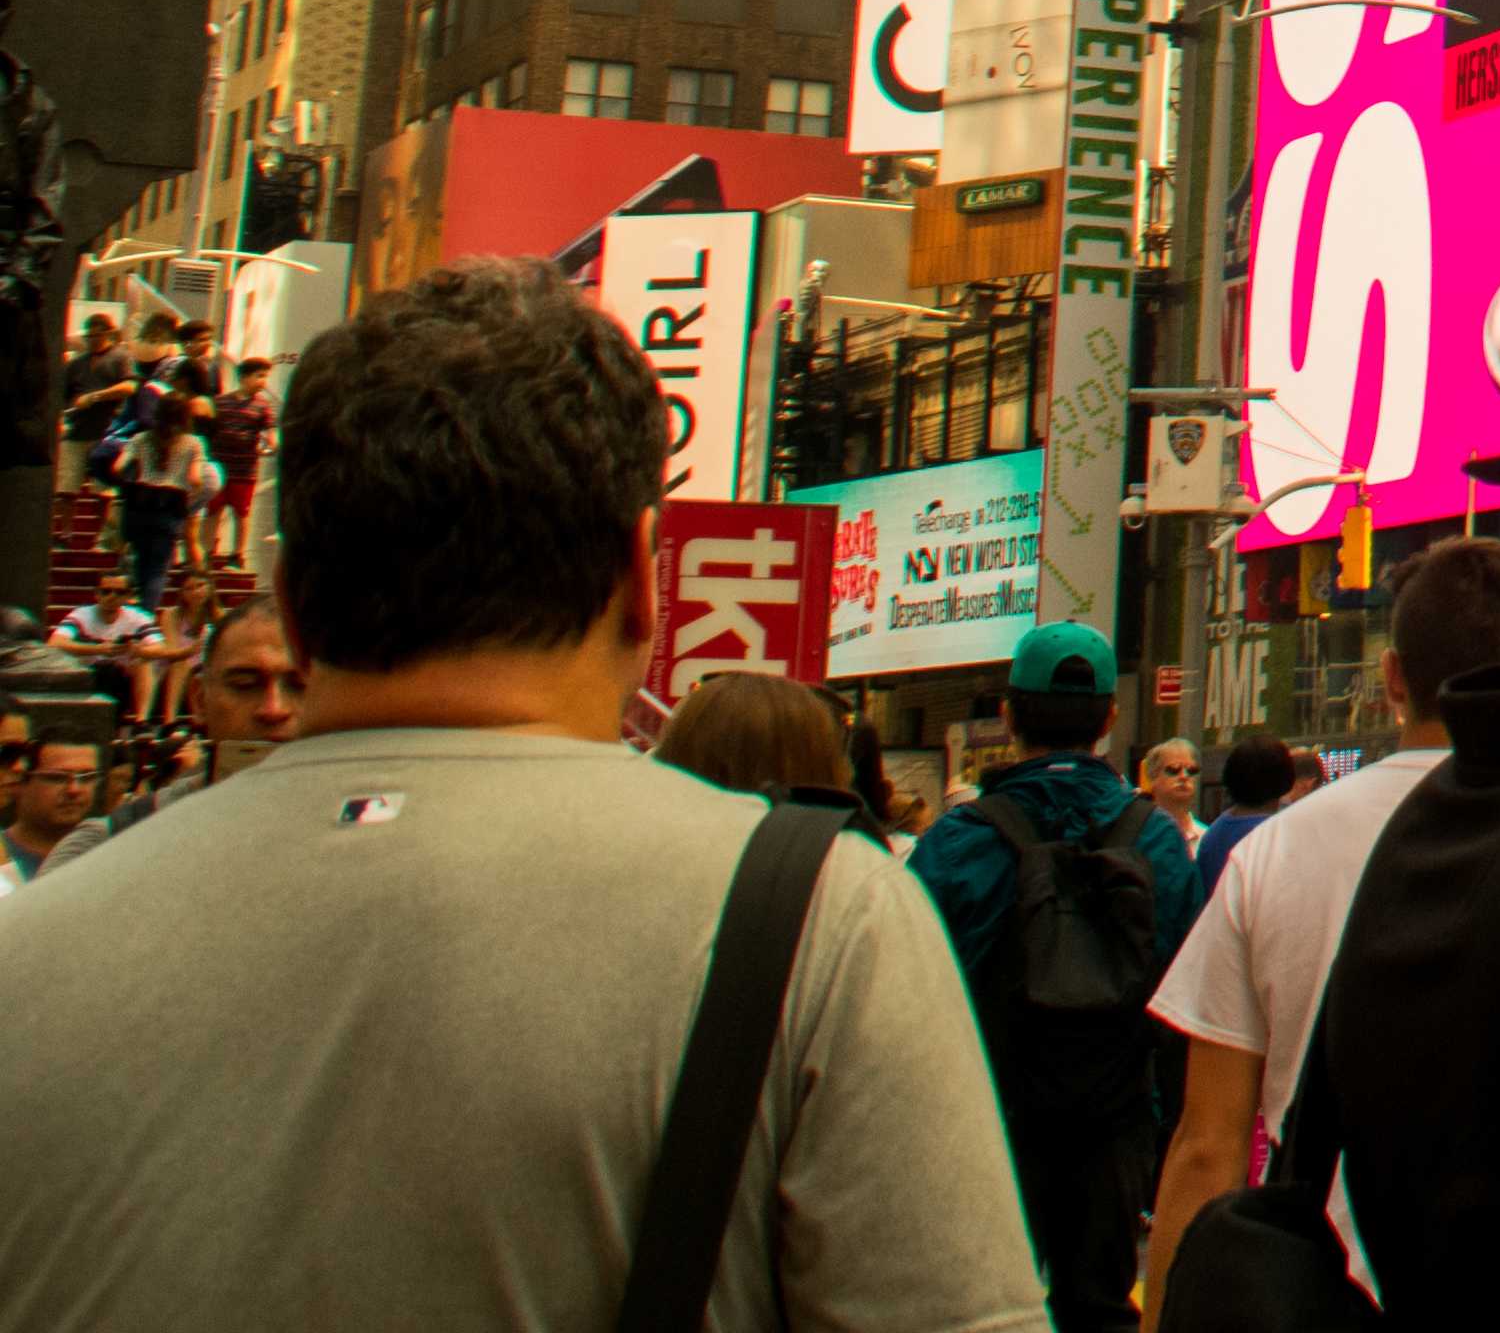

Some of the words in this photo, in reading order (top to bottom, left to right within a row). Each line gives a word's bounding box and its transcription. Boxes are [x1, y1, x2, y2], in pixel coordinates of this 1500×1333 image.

[965, 184, 1030, 207] LAMAR
[945, 543, 973, 577] NEW
[974, 535, 1017, 572] WORLD
[1018, 532, 1040, 567] STA
[669, 527, 801, 699] tkt
[651, 659, 667, 695] Devel
[1203, 639, 1271, 730] AME
